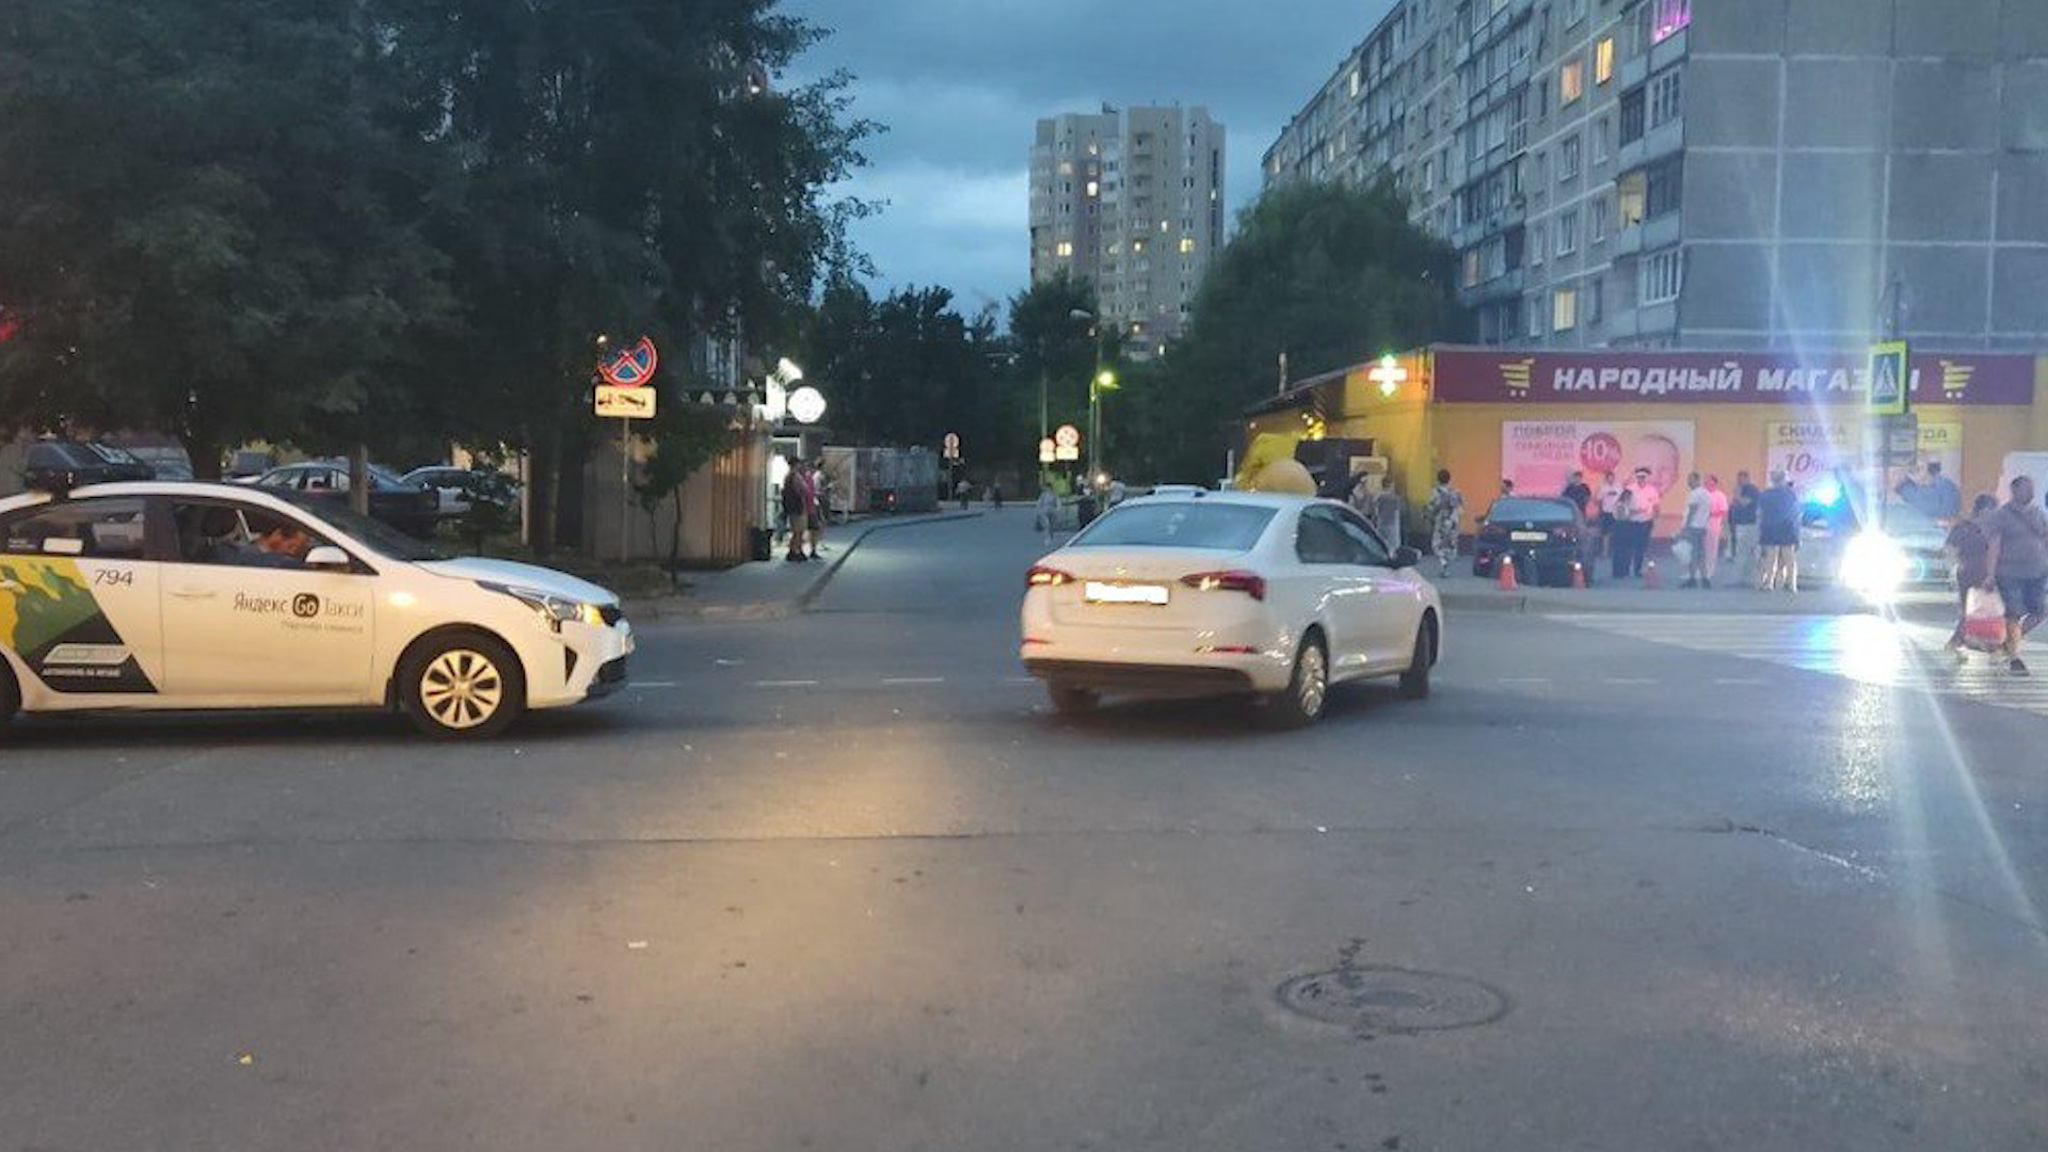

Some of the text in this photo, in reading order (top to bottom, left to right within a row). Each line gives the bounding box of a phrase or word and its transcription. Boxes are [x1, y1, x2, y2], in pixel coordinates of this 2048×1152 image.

[1552, 362, 1920, 395] НАРОДНЫЙ МАГАЗ
[95, 570, 133, 586] 794
[233, 591, 288, 612] Яндекс
[294, 594, 318, 616] Go
